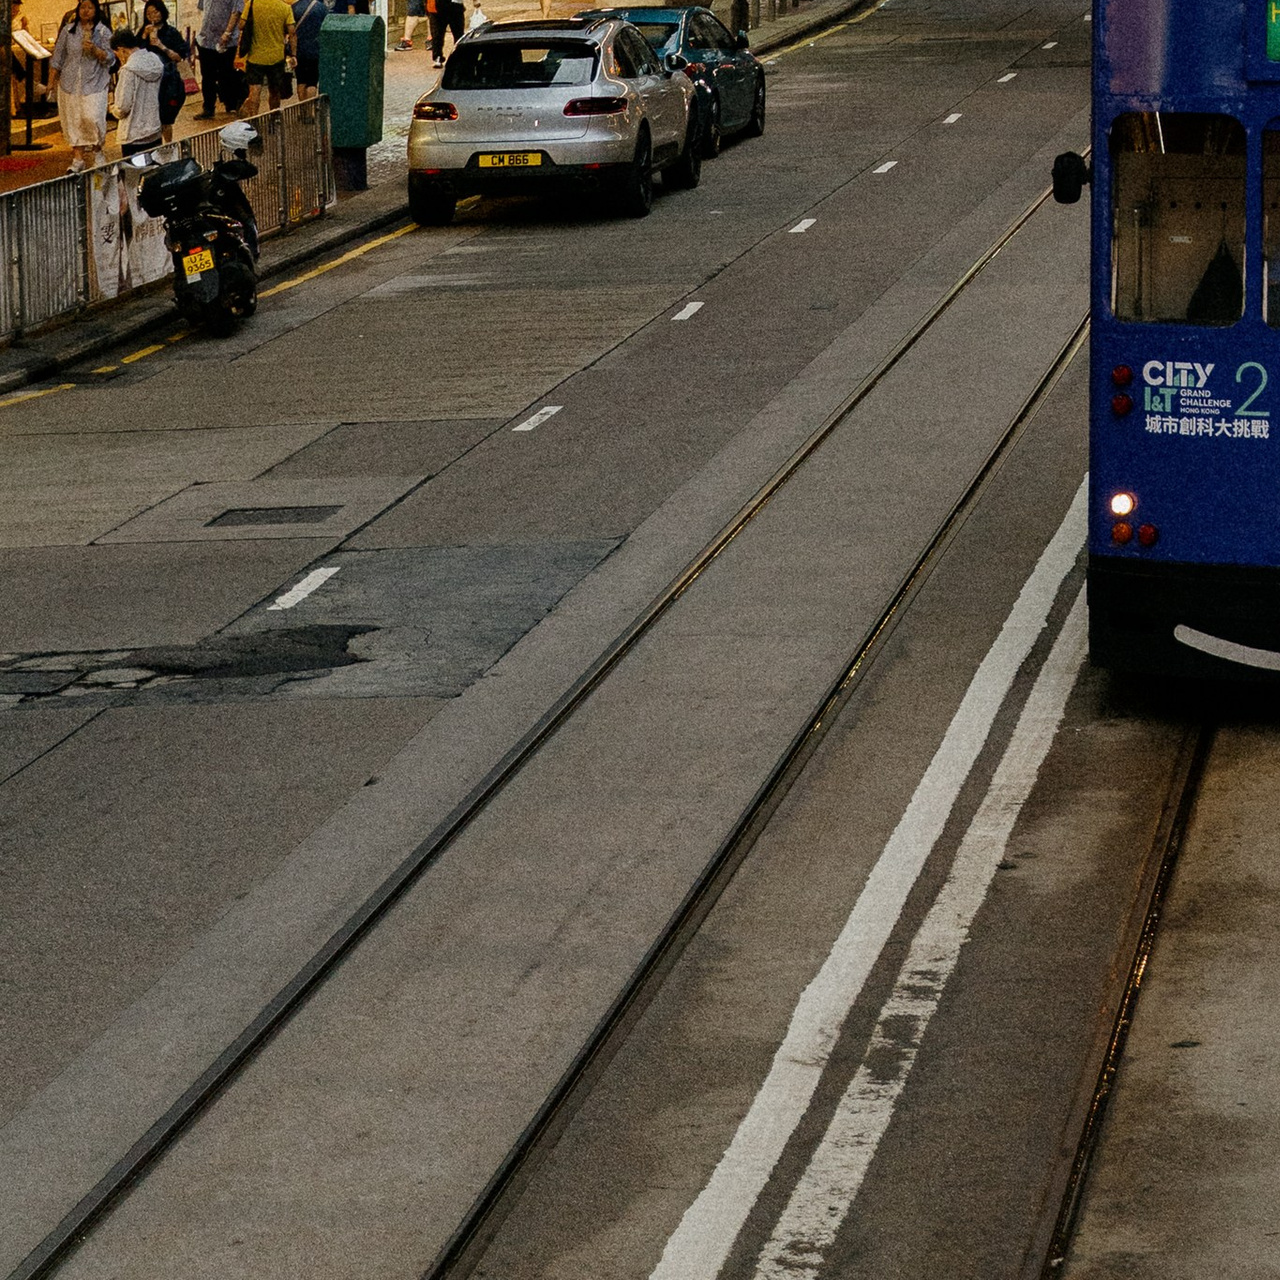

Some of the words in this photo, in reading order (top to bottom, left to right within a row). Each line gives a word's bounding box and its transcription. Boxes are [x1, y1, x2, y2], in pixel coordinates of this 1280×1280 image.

[491, 155, 505, 166] CM
[508, 154, 529, 165] 866
[190, 253, 204, 264] UZ
[187, 260, 212, 274] 9365
[1142, 360, 1215, 388] CITY
[1180, 389, 1211, 398] GRAND
[1234, 361, 1270, 417] 2
[1144, 386, 1177, 412] I&T
[1180, 398, 1232, 408] CHALLENGE
[1145, 414, 1270, 439] 城市創科大挑戰
